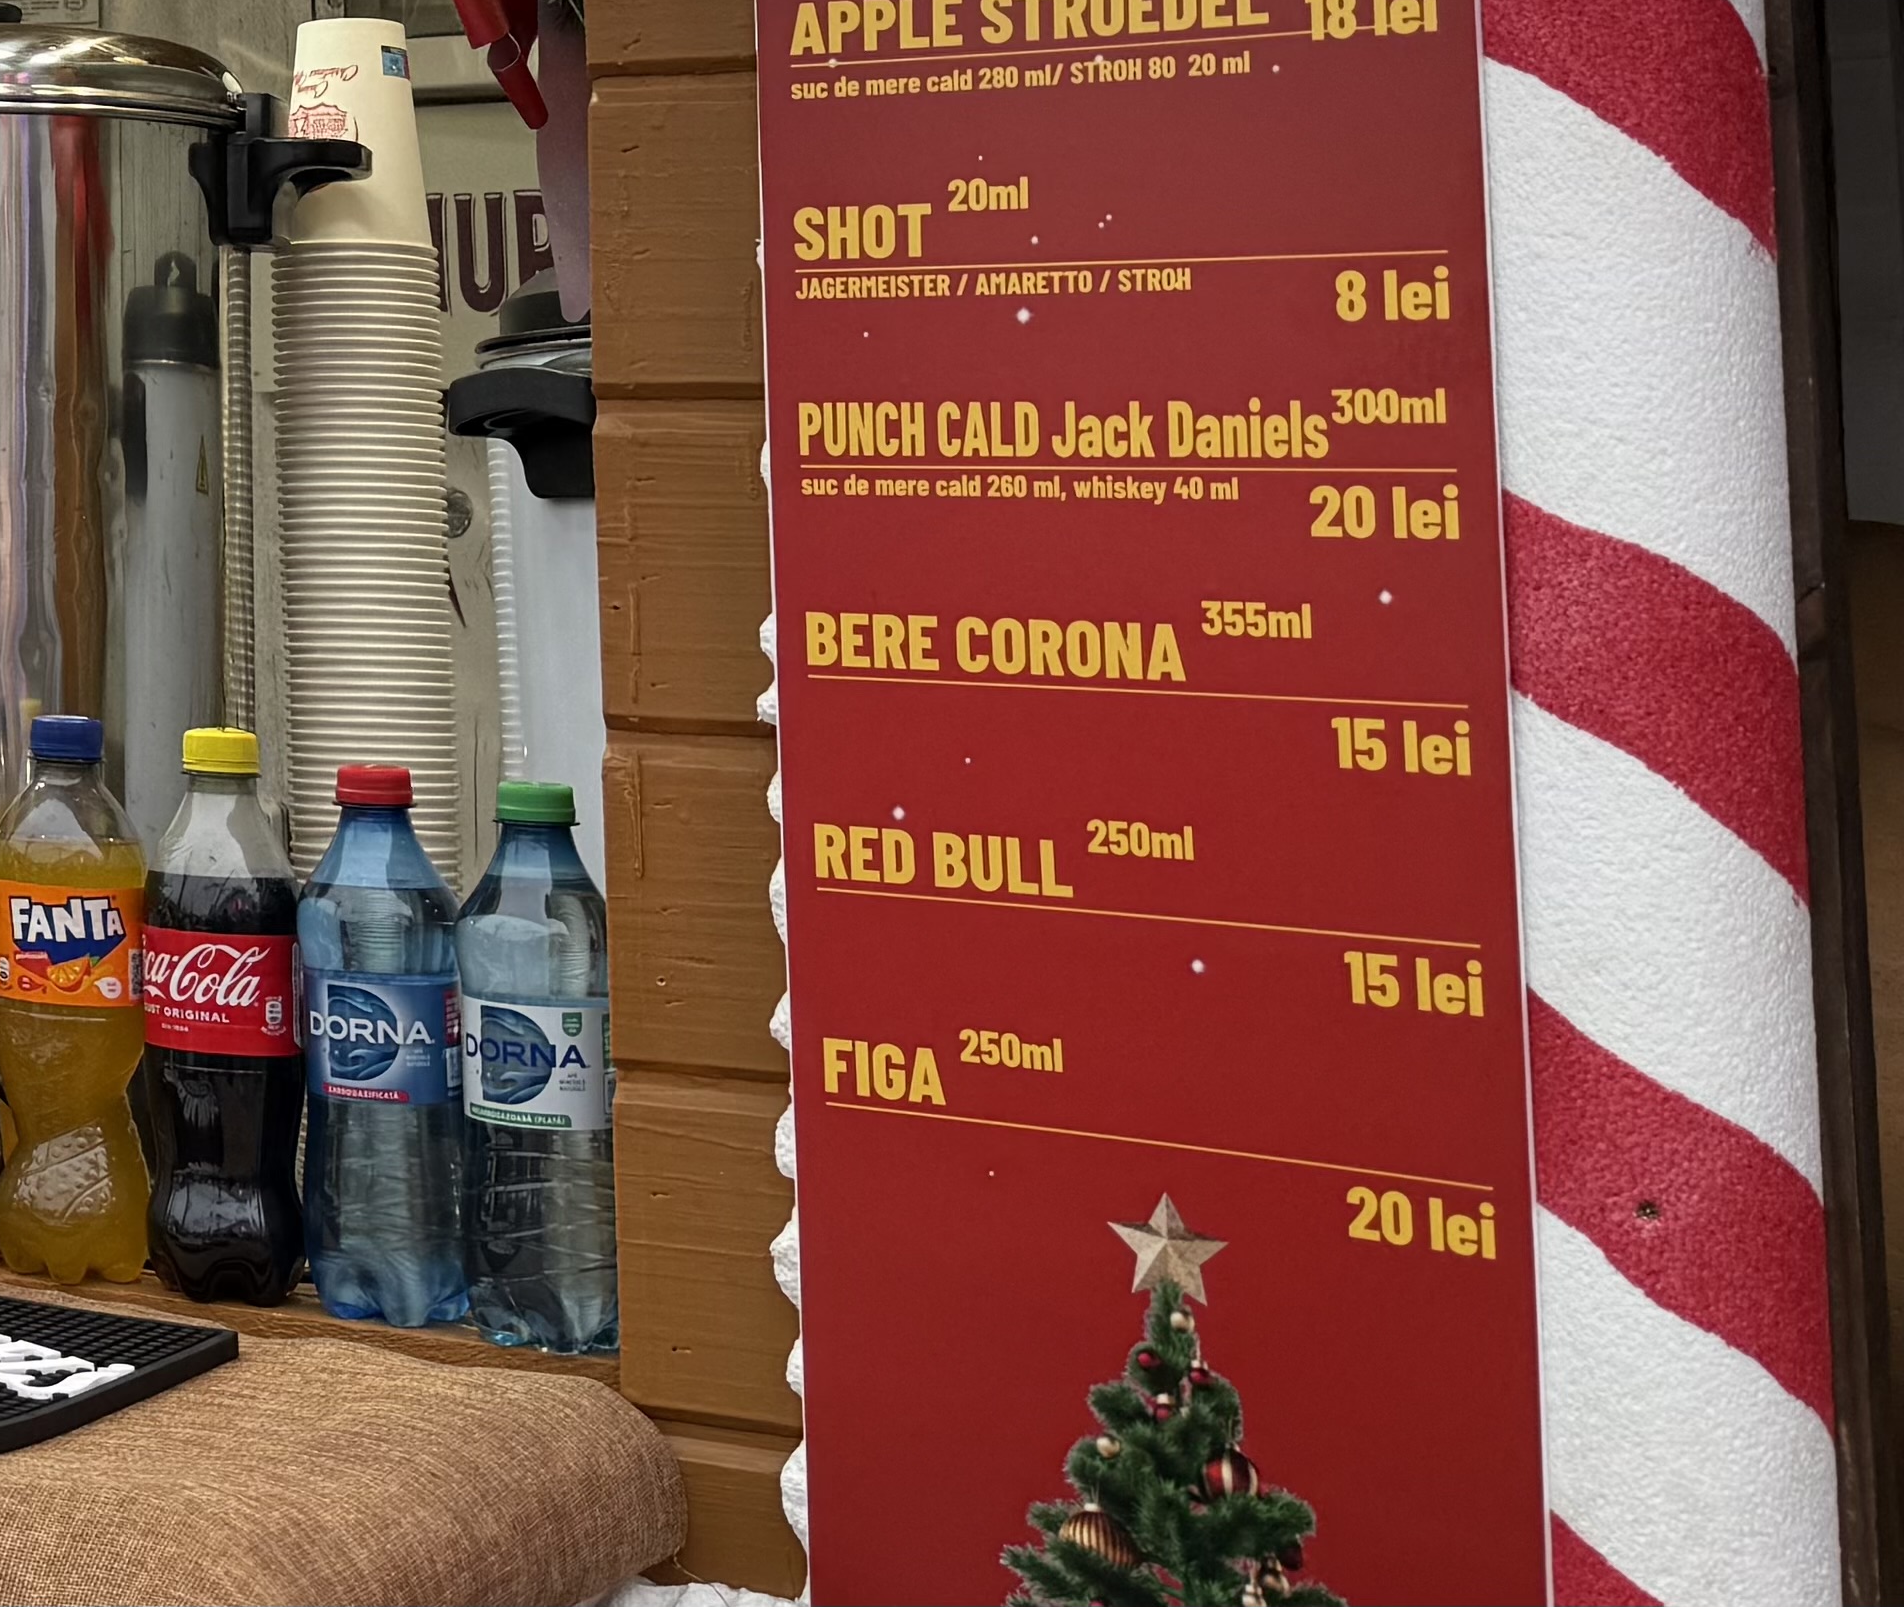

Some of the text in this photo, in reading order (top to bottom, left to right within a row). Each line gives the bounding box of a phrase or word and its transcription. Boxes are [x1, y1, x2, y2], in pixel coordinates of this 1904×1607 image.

[791, 51, 1250, 100] suc de mere cald 280 ml/ STROH 80 20 ml
[794, 177, 1030, 262] SHOT 20ml
[795, 272, 950, 301] JAGERMEISTER
[975, 268, 1093, 297] AMARETTO
[1118, 266, 1192, 292] STROH
[1335, 266, 1451, 321] 8 lei
[798, 389, 1447, 460] PUNCH CALD Jack Daniels 300ml
[801, 474, 1239, 506] suc de mere cald 260 ml, whiskey 40 ml
[1309, 485, 1460, 540] 20 lei
[805, 601, 1312, 682] BERE CORONA 355ml
[1331, 717, 1472, 776] 15 lei
[813, 821, 1194, 898] RED BULL 250ml
[9, 896, 124, 942] FANTA
[1344, 952, 1485, 1017] 15 lei
[164, 1006, 229, 1023] ORIGINAL
[310, 1010, 431, 1044] DORNA
[466, 1033, 587, 1068] DORNA
[822, 1030, 1063, 1105] FIGA 250ml
[1347, 1187, 1496, 1259] 20 lei
